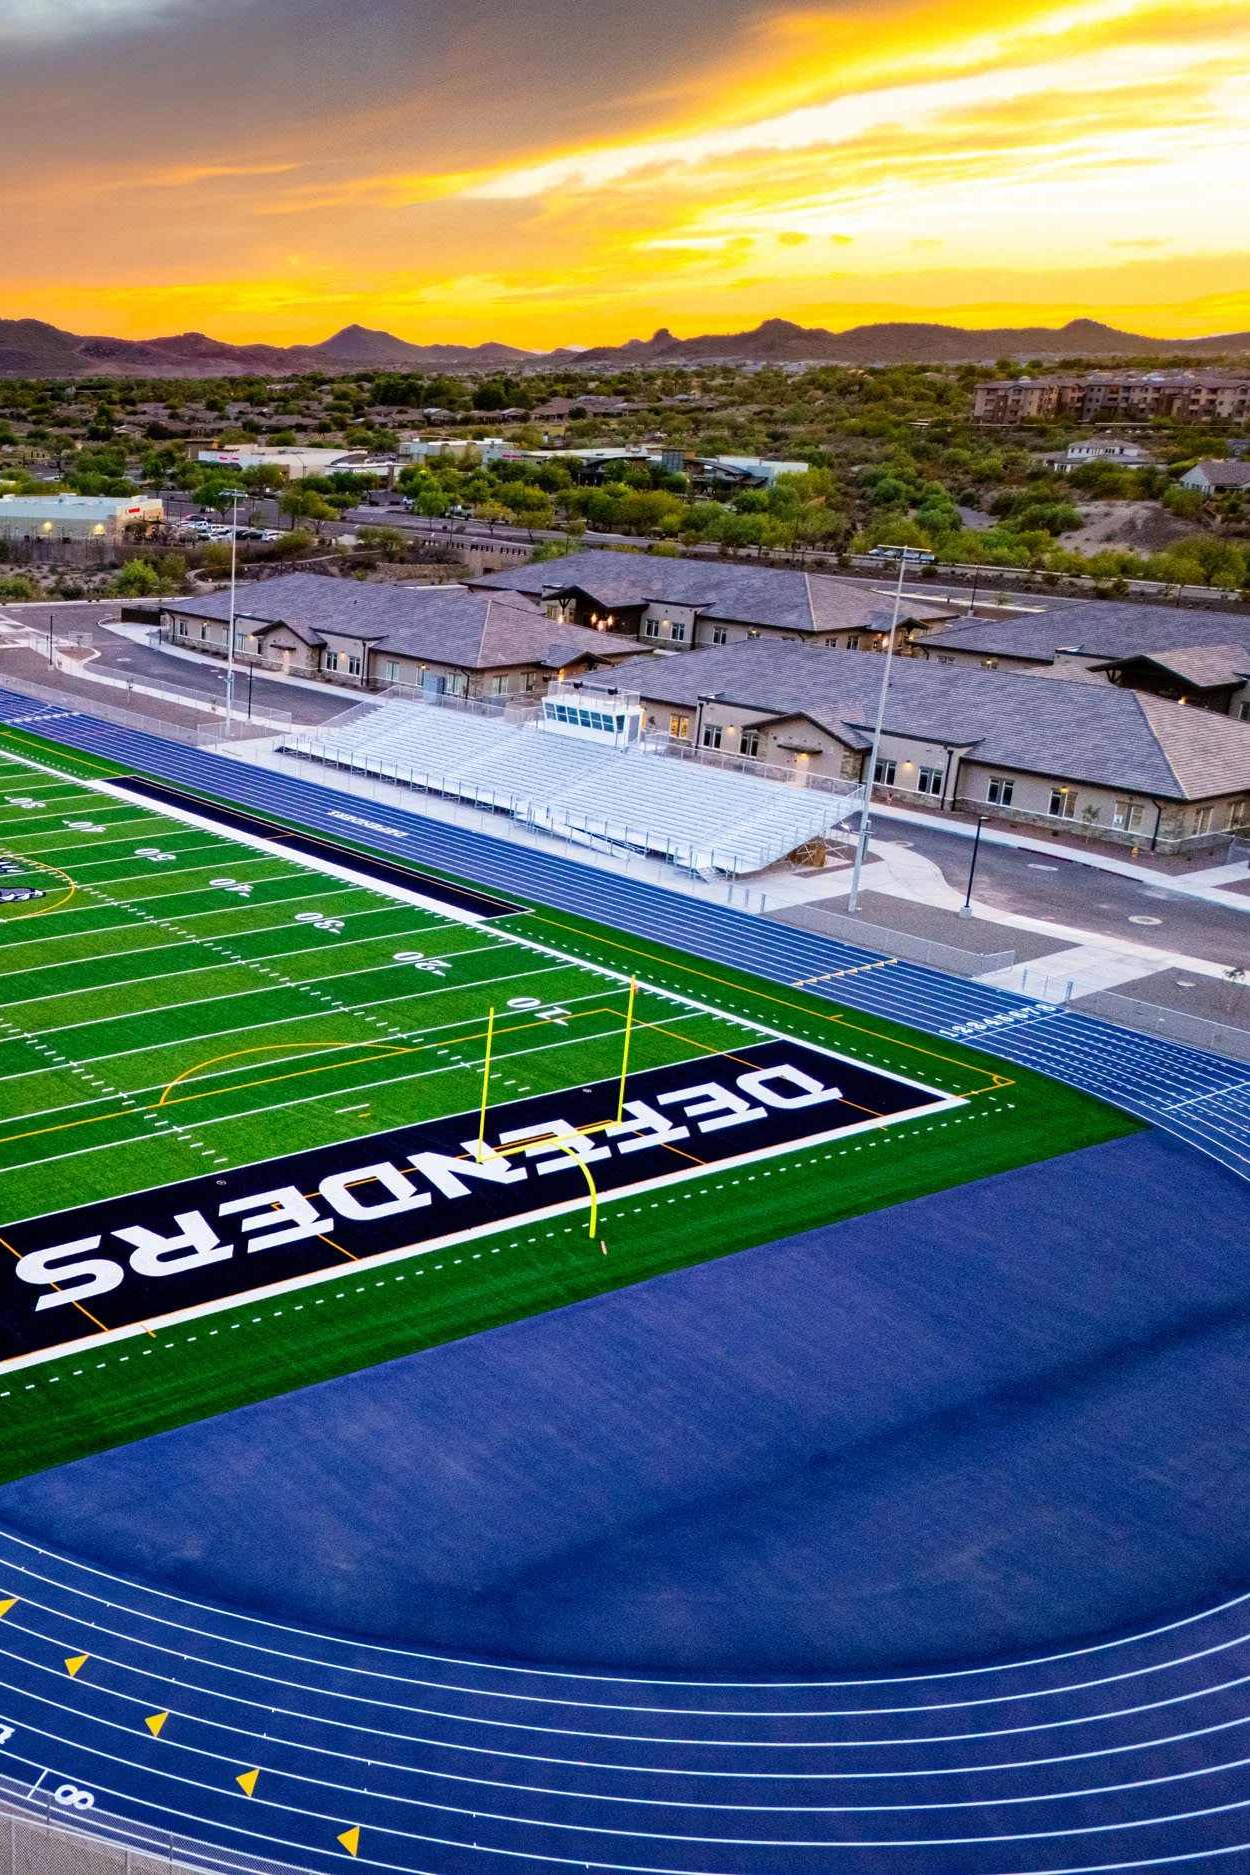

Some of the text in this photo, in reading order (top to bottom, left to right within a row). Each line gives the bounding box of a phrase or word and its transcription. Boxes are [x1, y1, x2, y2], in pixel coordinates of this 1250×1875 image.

[68, 821, 107, 833] 40
[326, 810, 409, 837] DEFENDERS
[134, 848, 177, 862] 50
[209, 878, 254, 893] 40
[294, 912, 345, 931] 30
[392, 951, 452, 971] 20
[506, 997, 572, 1020] 10
[939, 1029, 958, 1037] 1
[952, 1025, 973, 1033] 2
[983, 1018, 1002, 1026] 4
[1021, 1007, 1041, 1015] 7
[1035, 1003, 1056, 1012] 8
[15, 1063, 843, 1311] DEFENDERS
[54, 1784, 95, 1810] 8
